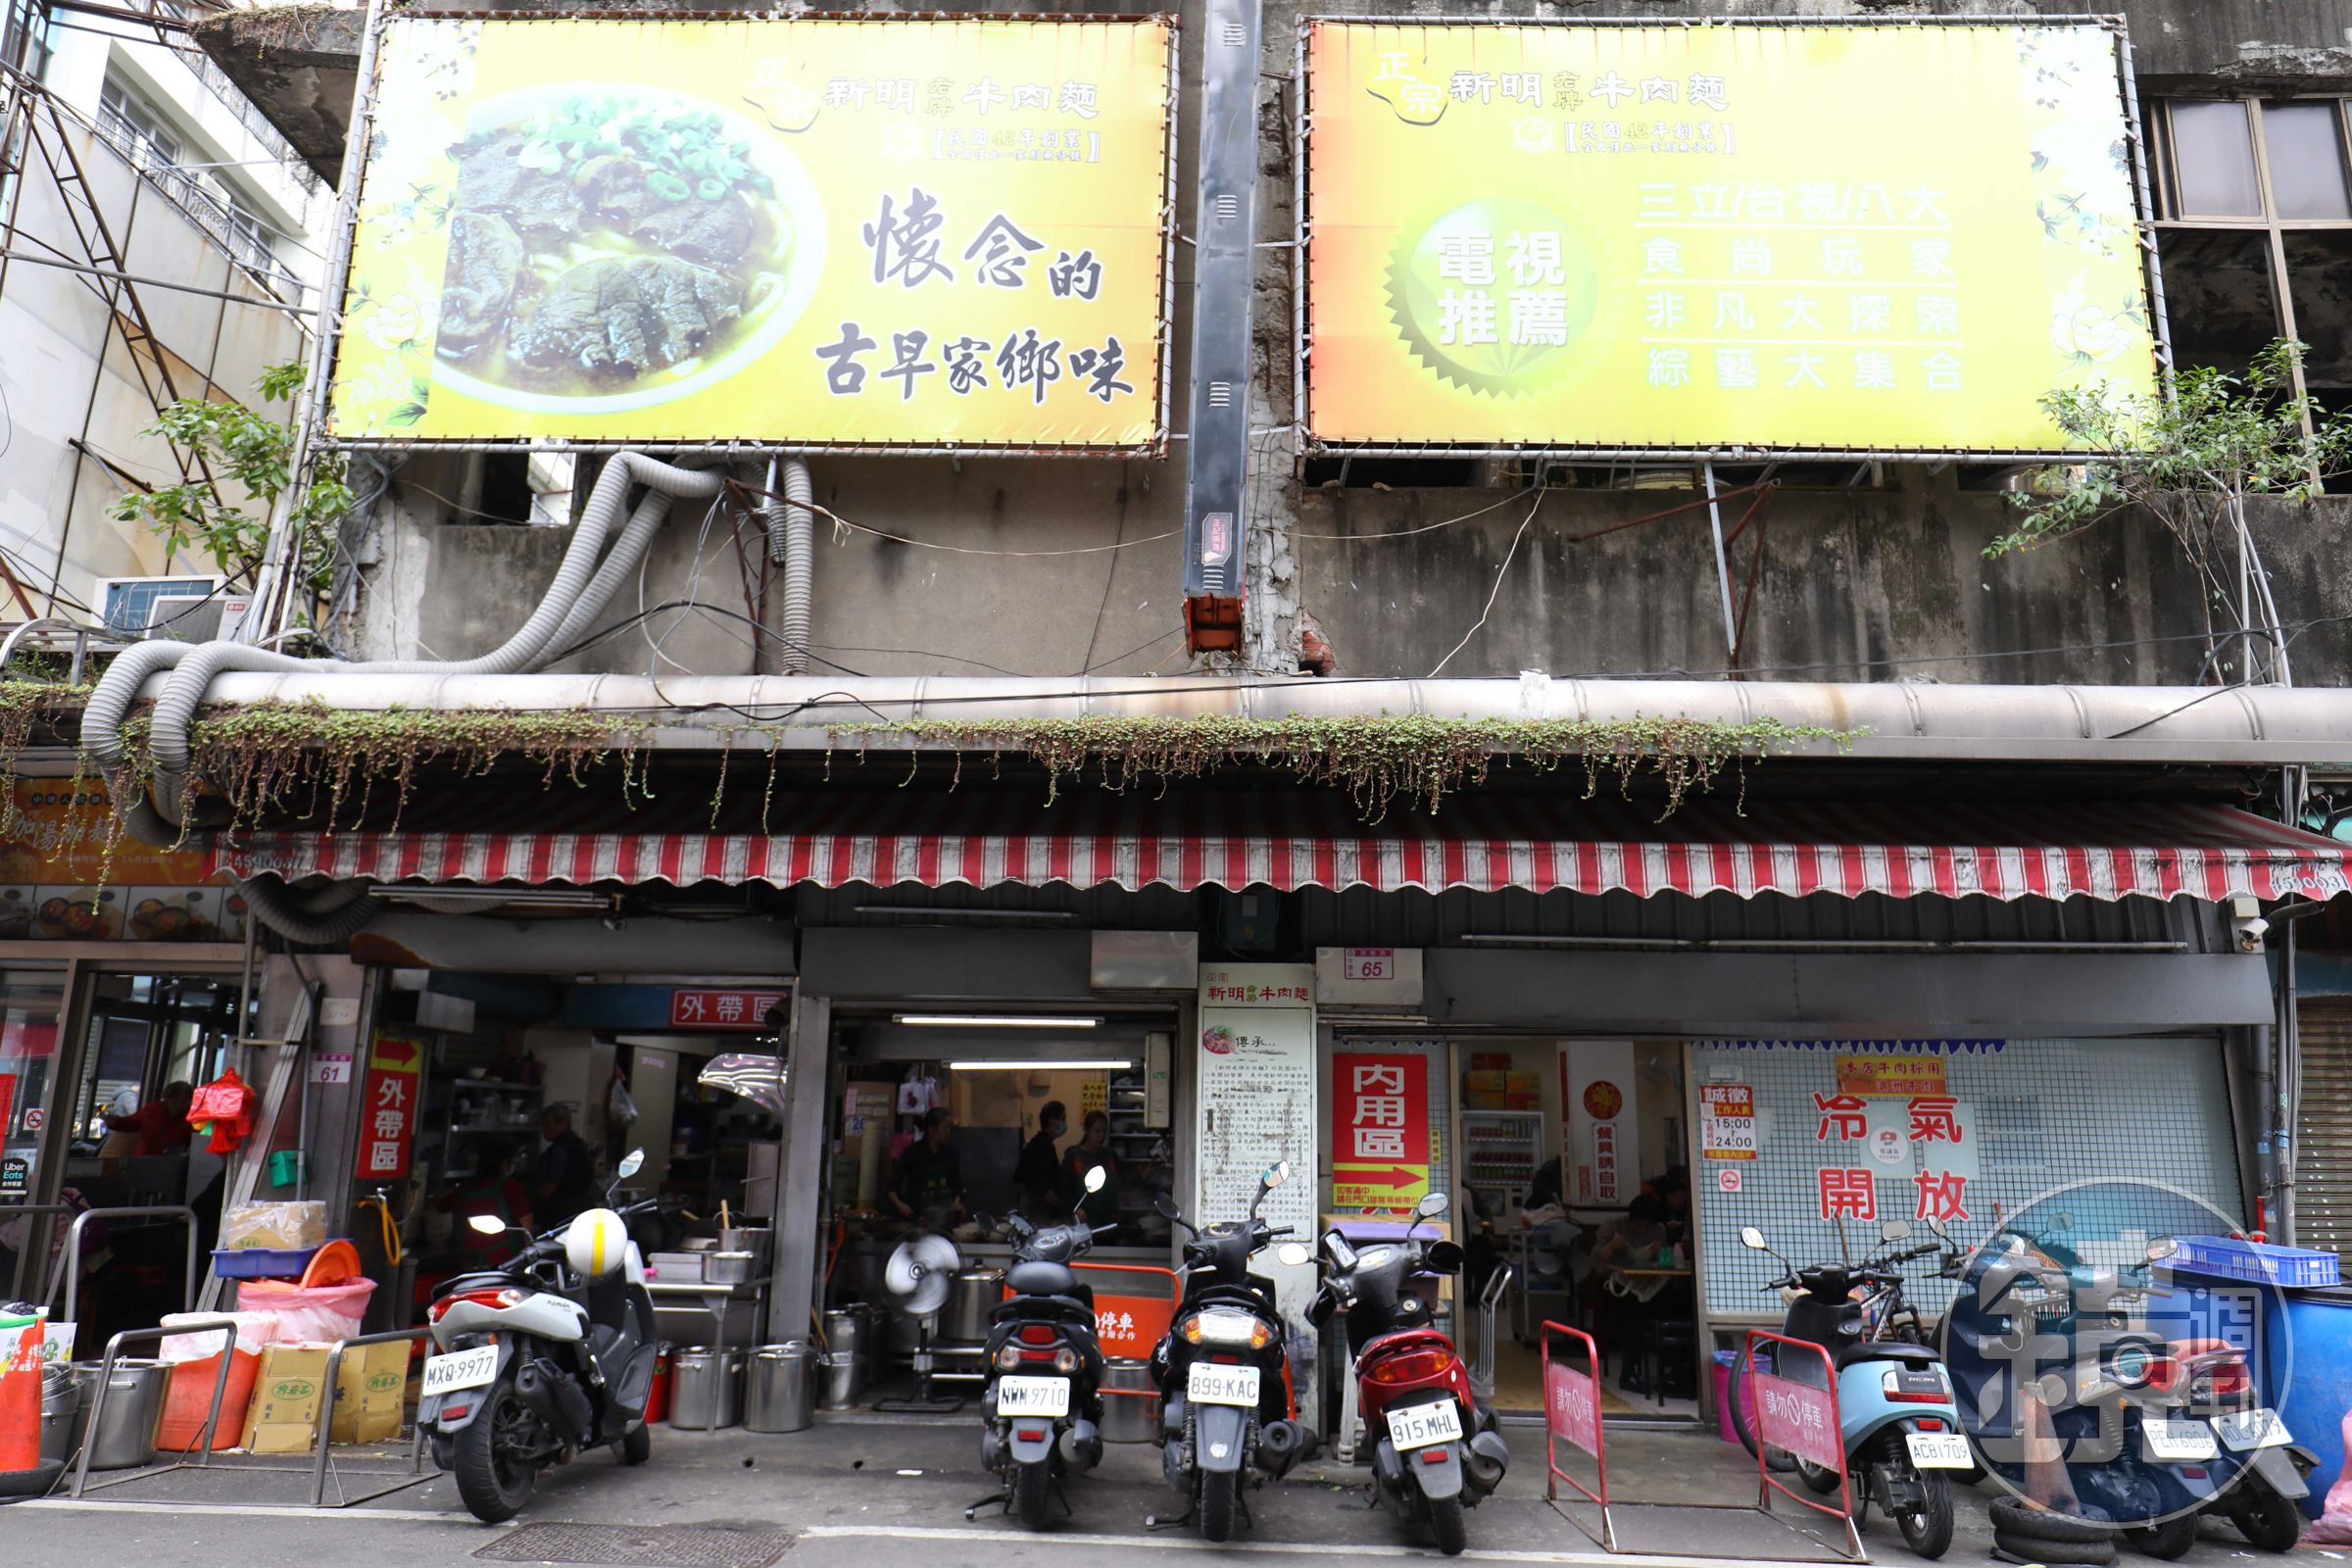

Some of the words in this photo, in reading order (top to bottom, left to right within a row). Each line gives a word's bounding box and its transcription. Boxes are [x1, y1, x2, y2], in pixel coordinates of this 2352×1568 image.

[1375, 52, 1443, 114] 正宗
[1639, 180, 1948, 221] 三立/台視/八大
[863, 187, 1102, 300] 懷念的
[1437, 231, 1565, 288] 電視
[1642, 234, 1955, 276] 食尚玩家
[1438, 289, 1568, 348] 推薦
[1645, 290, 1959, 335] 非凡大探索
[815, 321, 1134, 404] 古早家鄉味
[1647, 346, 1965, 393] 綜藝大集合
[1362, 961, 1382, 976] 65
[681, 995, 781, 1021] 外帶區
[320, 1066, 339, 1081] 61
[1704, 1087, 1749, 1103] 誠徵
[369, 1077, 406, 1171] 外帶區
[1351, 1064, 1405, 1158] 內用區
[1716, 1118, 1751, 1128] 15:00
[1813, 1092, 1963, 1144] 冷氣
[1716, 1137, 1752, 1148] 24:00
[1819, 1168, 1970, 1222] 開放
[1095, 1311, 1135, 1330] 停車
[427, 1356, 494, 1387] MXQ-9977
[1191, 1376, 1257, 1399] 899-KAC
